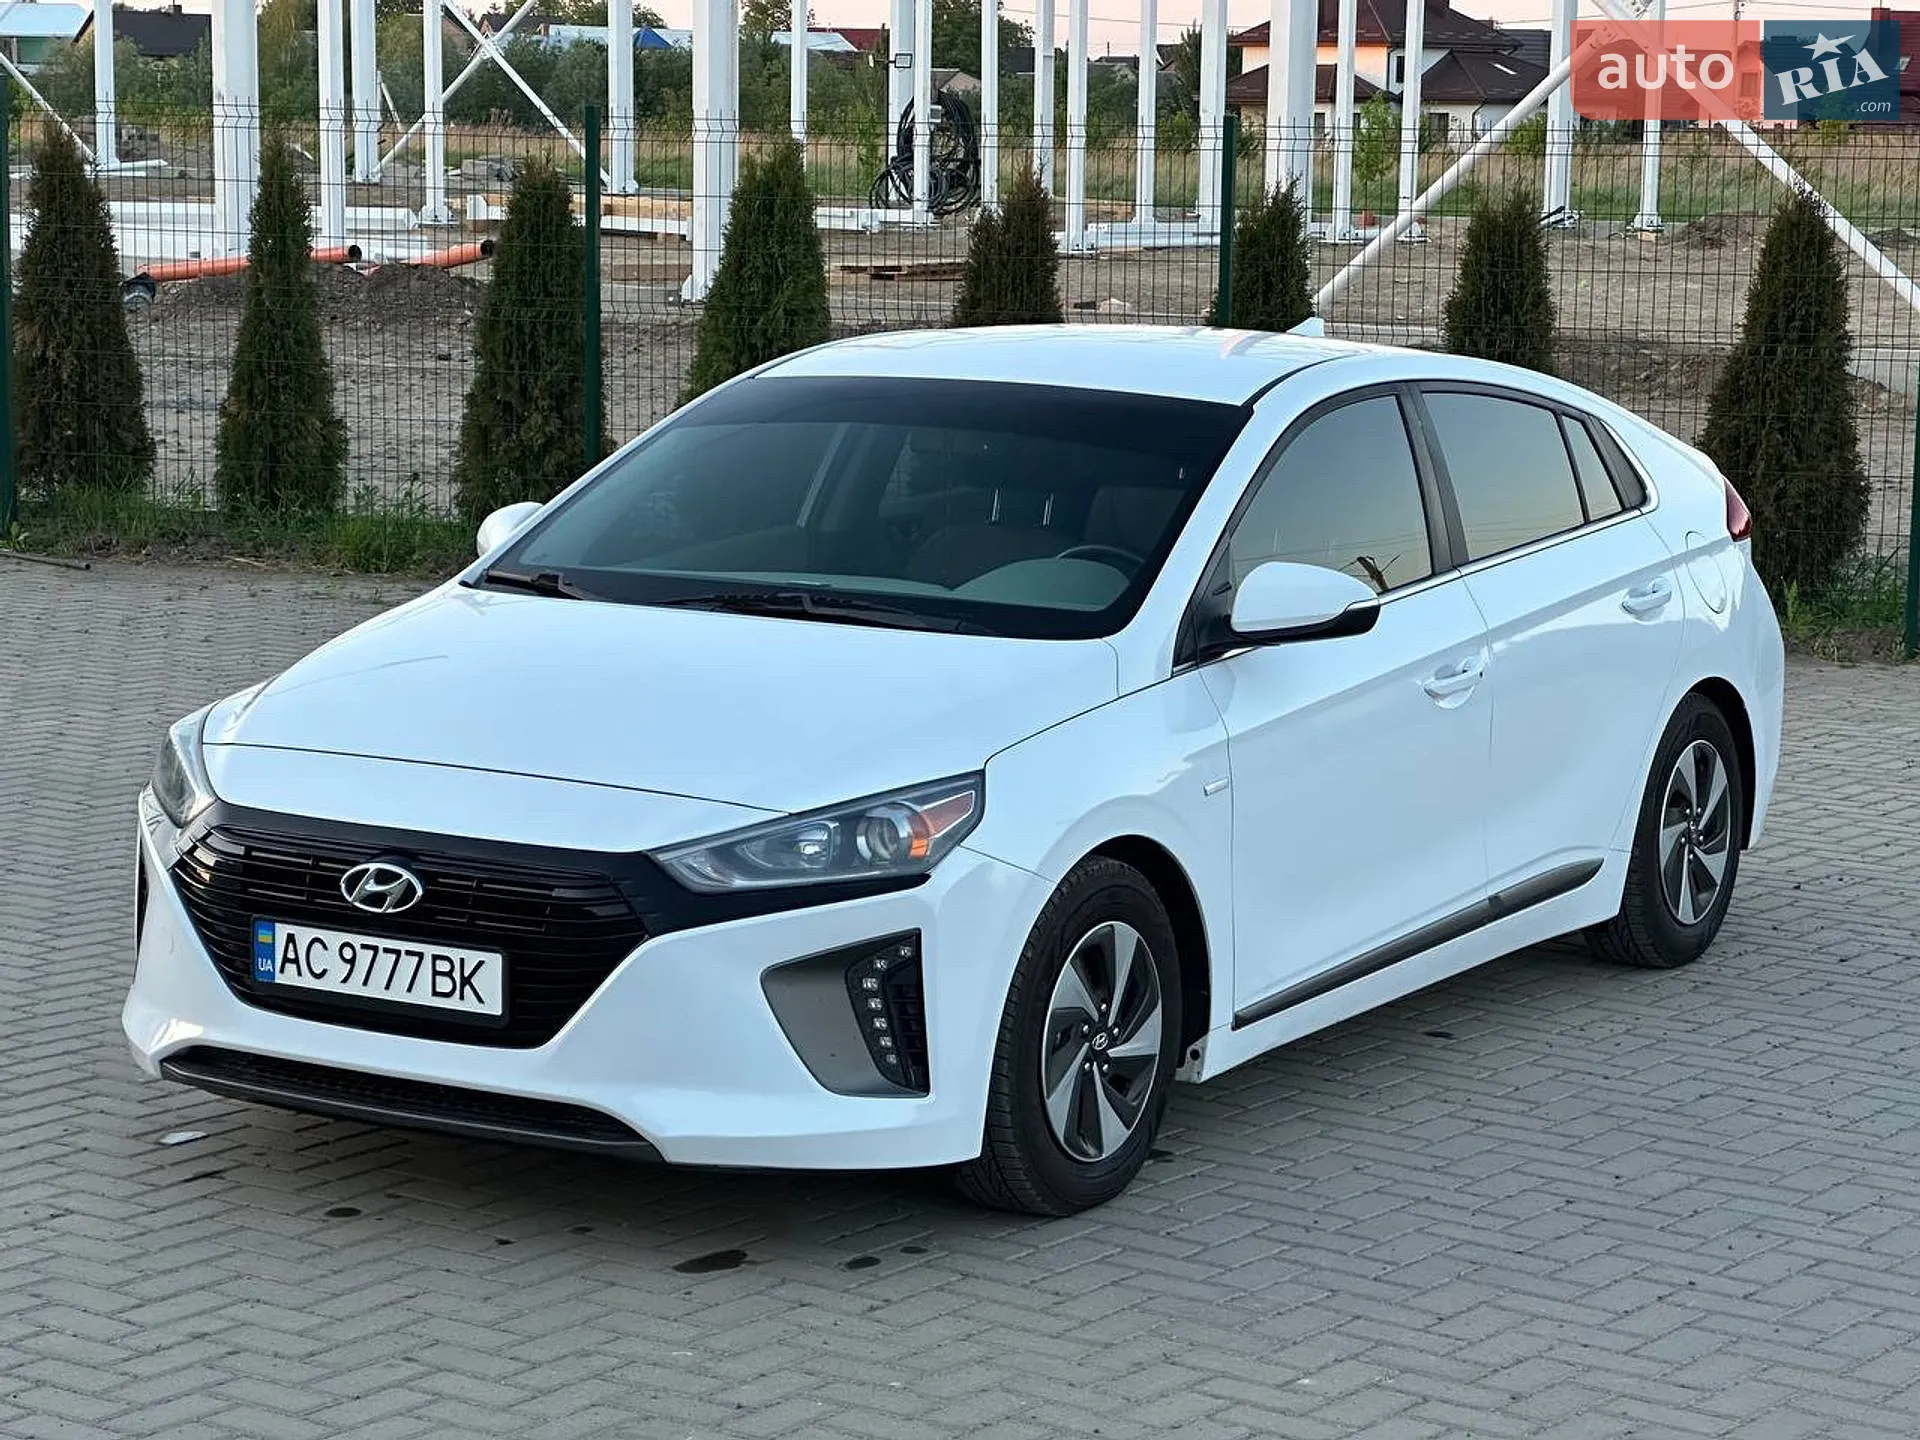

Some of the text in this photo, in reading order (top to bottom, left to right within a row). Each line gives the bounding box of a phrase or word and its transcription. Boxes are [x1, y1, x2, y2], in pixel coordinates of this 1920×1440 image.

[258, 958, 274, 972] UA
[279, 933, 485, 1004] AC 9777 BK
